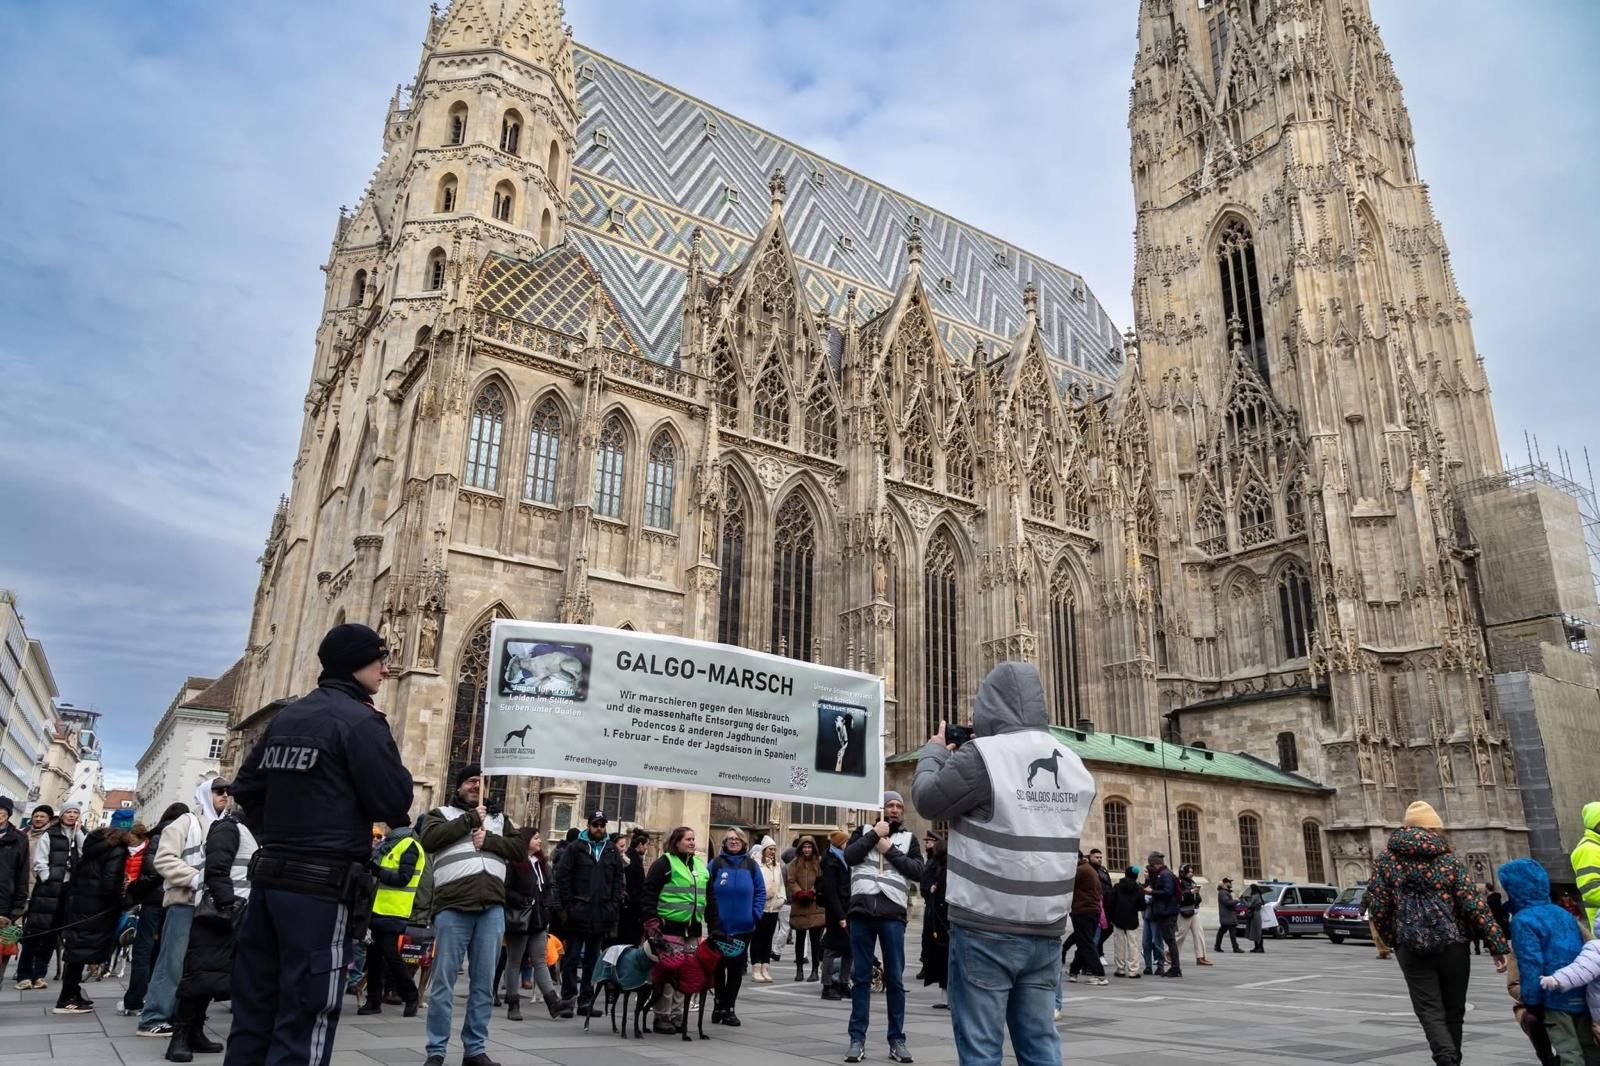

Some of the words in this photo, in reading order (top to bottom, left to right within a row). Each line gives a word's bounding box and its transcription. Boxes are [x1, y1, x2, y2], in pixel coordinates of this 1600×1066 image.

[616, 650, 794, 697] GALGO-MARSCH
[500, 703, 529, 712] Sterben
[509, 694, 535, 702] Leiden
[537, 695, 547, 703] im
[619, 689, 636, 701] Wir
[639, 693, 697, 709] marschieren
[699, 702, 726, 713] gegen
[728, 705, 743, 715] den
[746, 707, 790, 722] Missbrauch
[606, 703, 624, 712] und
[627, 704, 641, 715] die
[643, 708, 703, 723] massenhafte
[705, 714, 754, 731] Entsorgung
[755, 721, 769, 732] der
[631, 718, 676, 732] Podencos
[678, 724, 685, 733] &
[688, 726, 724, 738] anderen
[726, 731, 778, 746] Jagdhunden!
[603, 728, 610, 738] 1.
[612, 729, 651, 742] Februar
[662, 735, 685, 746] Ende
[687, 739, 702, 748] der
[705, 741, 752, 755] Jagdsaison
[754, 746, 762, 755] in
[764, 748, 797, 760] Spanien!
[564, 754, 618, 768] #freethegalgo
[643, 763, 698, 776] #wearethevoice
[1026, 791, 1050, 802] GALGOS
